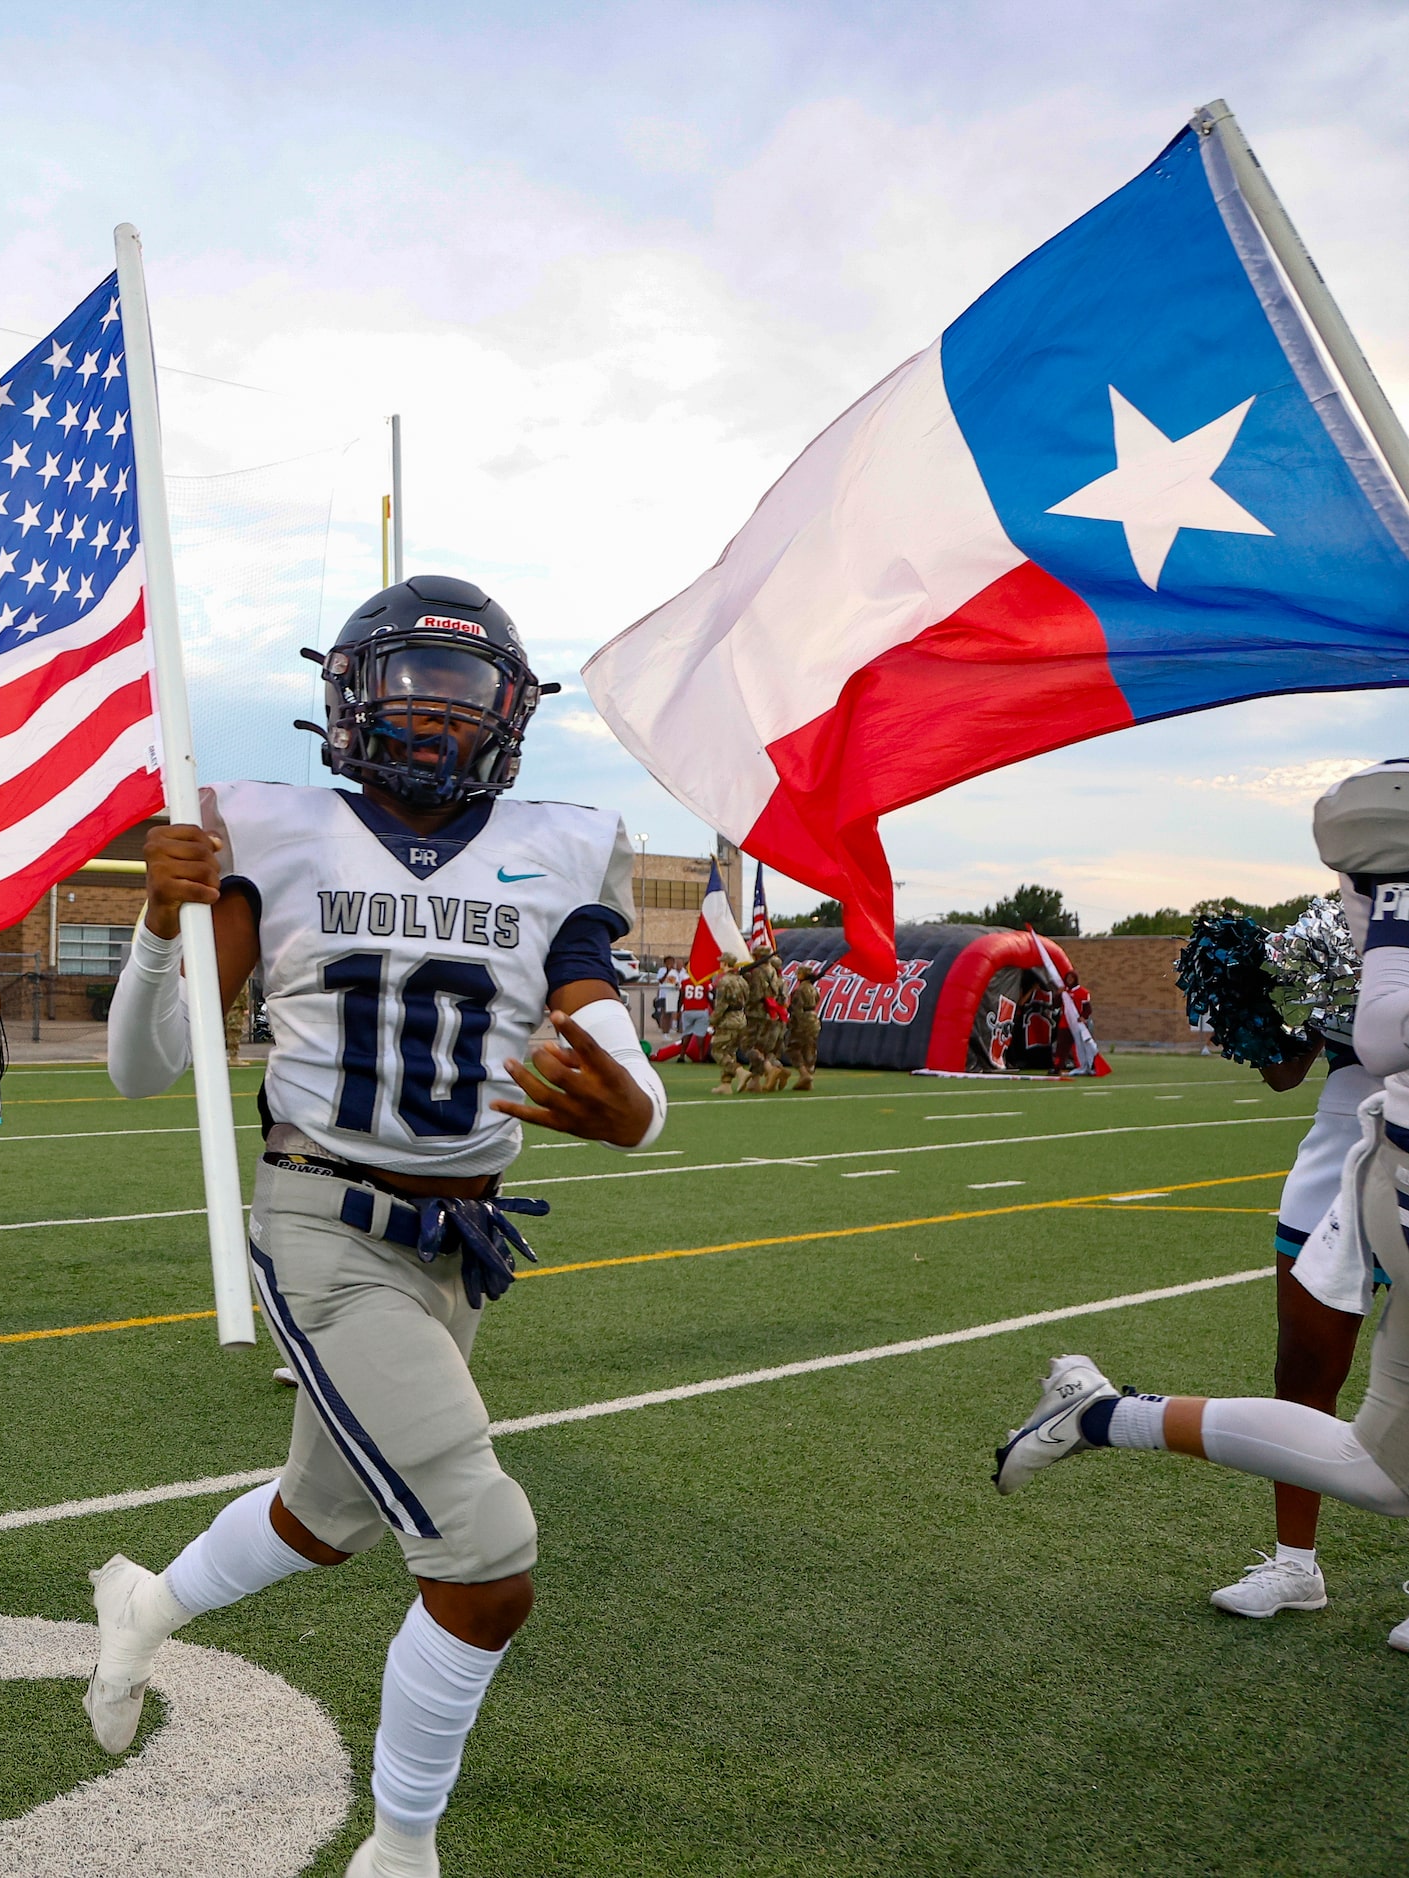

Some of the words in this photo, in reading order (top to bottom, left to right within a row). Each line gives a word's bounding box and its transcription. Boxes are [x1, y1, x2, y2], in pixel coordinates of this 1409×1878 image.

[424, 617, 481, 635] Riddell
[317, 890, 520, 950] WOLVES
[684, 984, 705, 1000] 66
[316, 946, 504, 1144] 10
